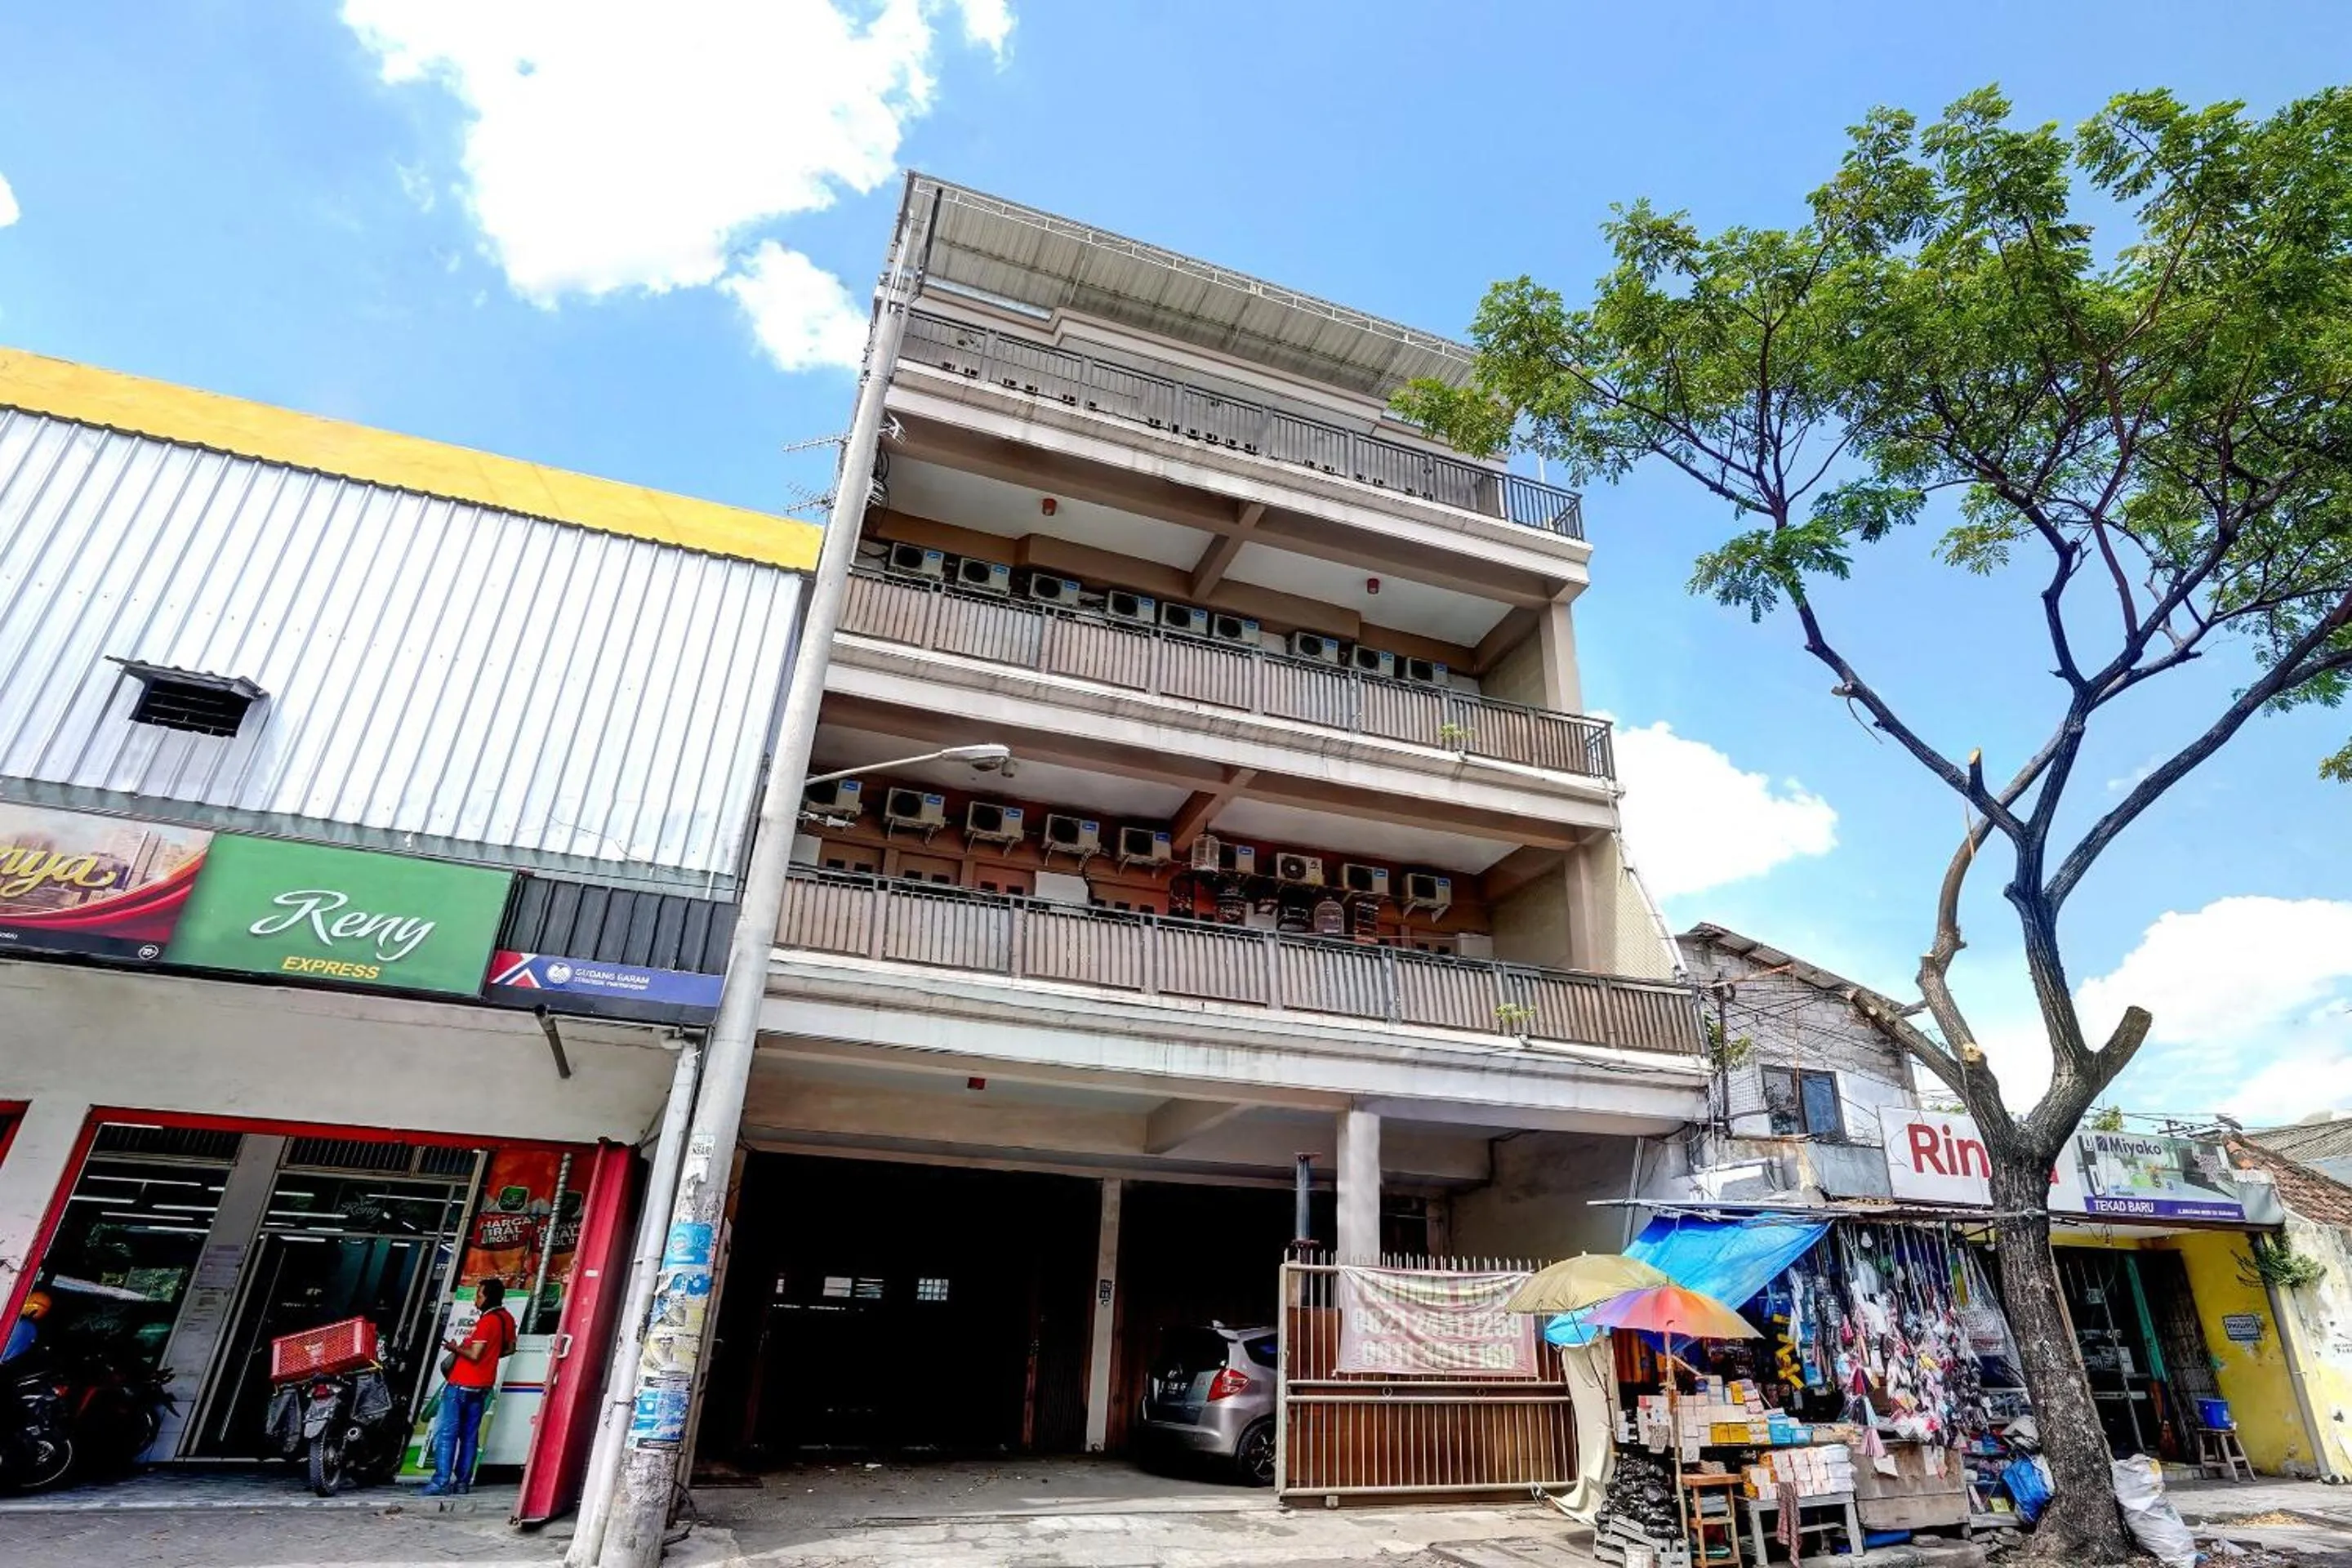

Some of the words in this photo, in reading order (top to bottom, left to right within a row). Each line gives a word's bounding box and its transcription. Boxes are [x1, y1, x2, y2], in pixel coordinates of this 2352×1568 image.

[249, 889, 437, 962] Reny
[281, 956, 381, 979] EXPRESS
[575, 969, 616, 981] GUDANG
[617, 971, 650, 984] GARAM
[2109, 1136, 2163, 1157] Miyako
[2093, 1200, 2126, 1212] TEKAD
[2127, 1201, 2154, 1214] BARU
[480, 1216, 532, 1230] HARGA
